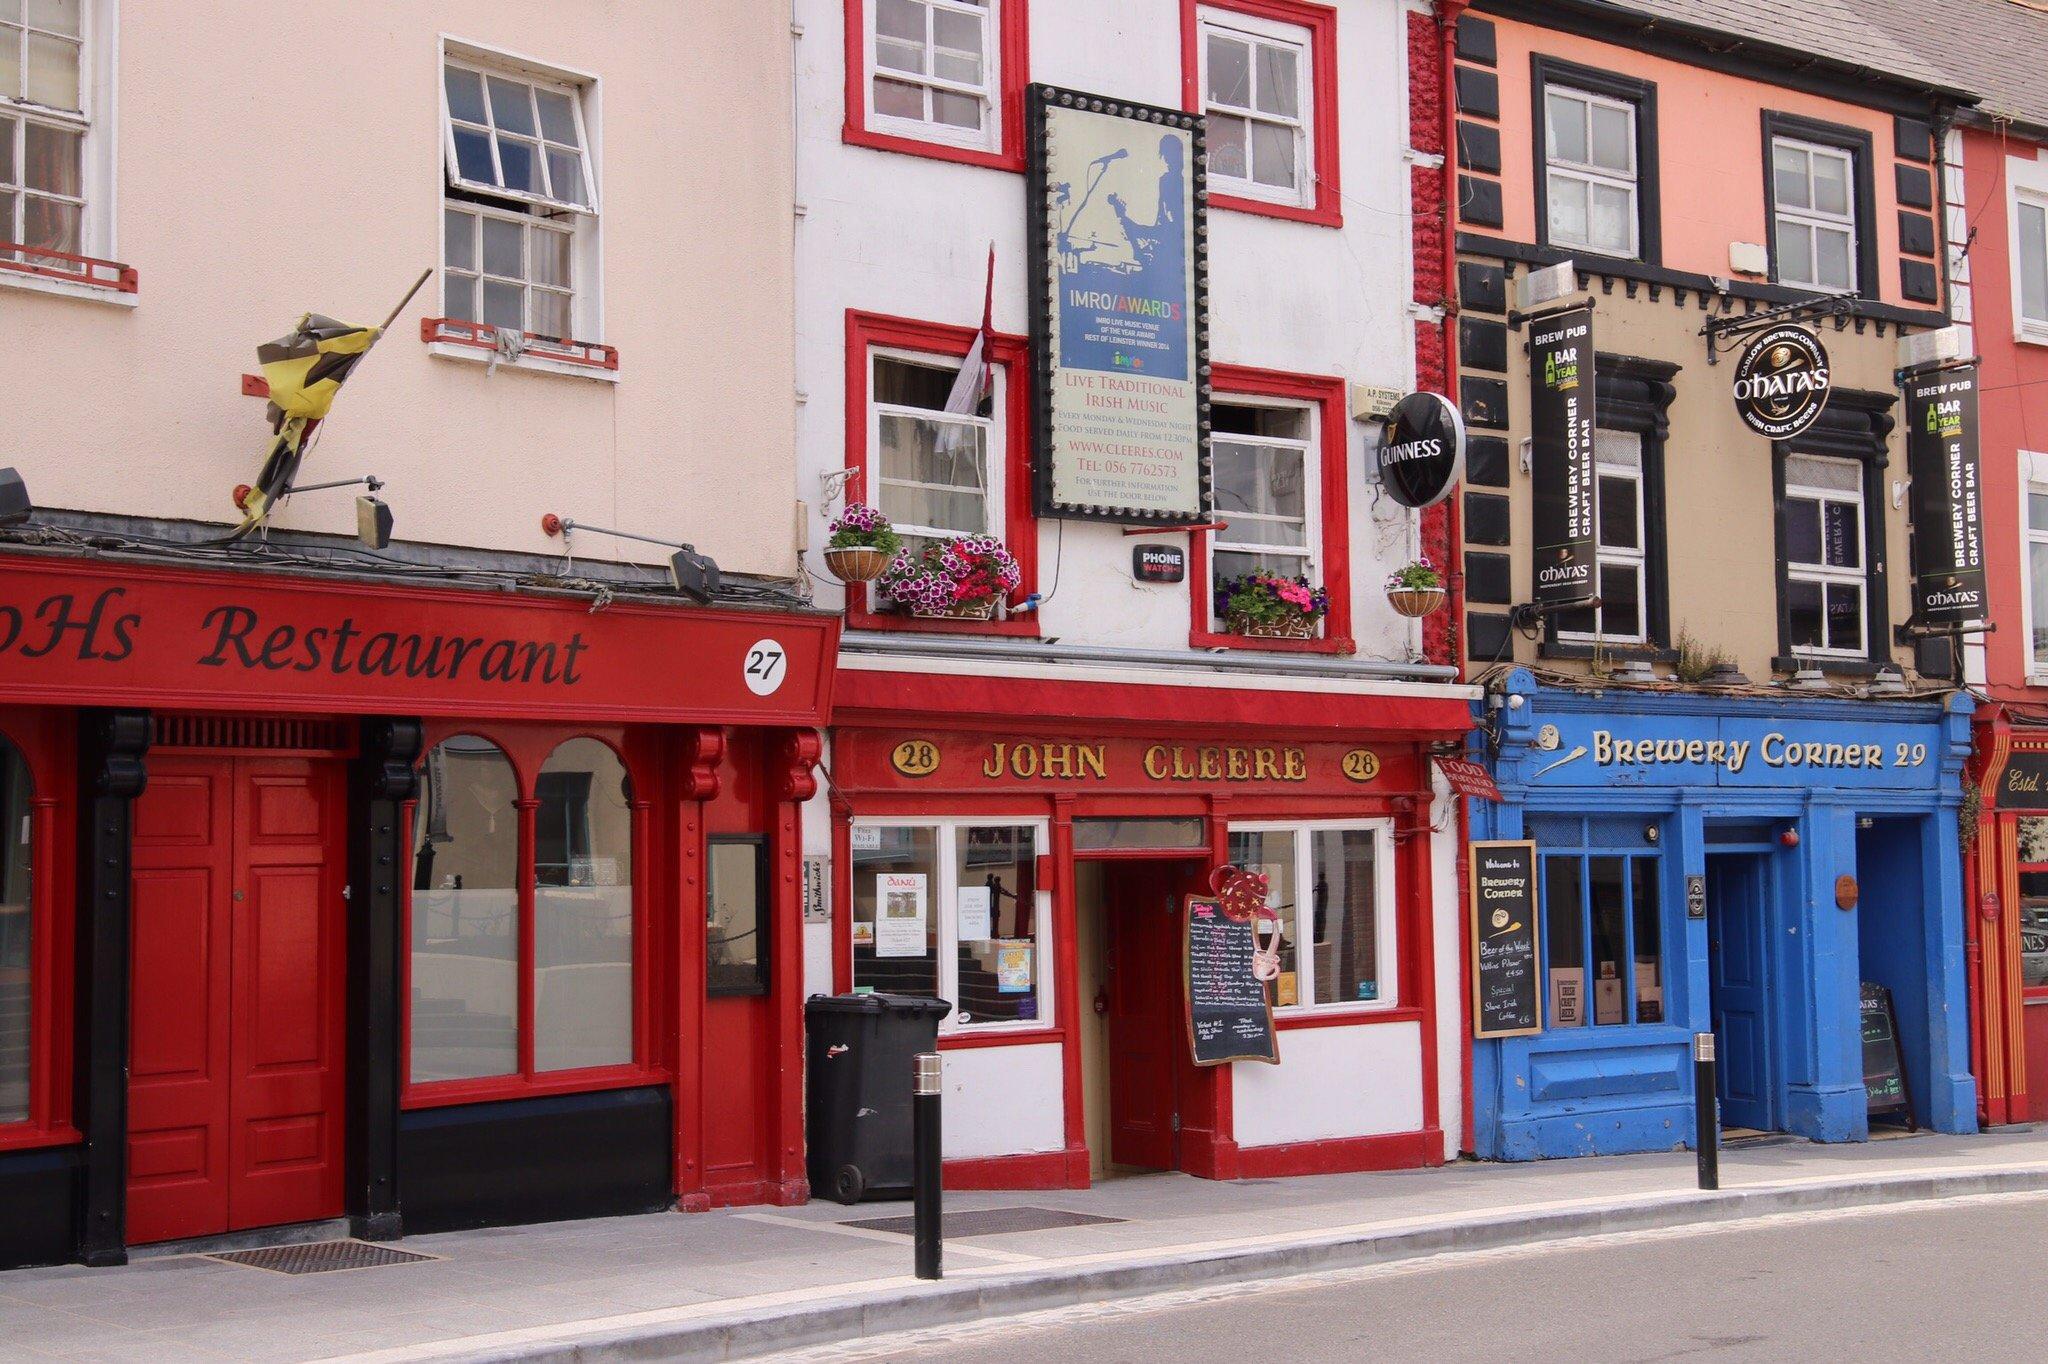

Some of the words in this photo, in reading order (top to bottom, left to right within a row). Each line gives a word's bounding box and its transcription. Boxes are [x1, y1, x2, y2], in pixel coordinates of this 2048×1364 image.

[1070, 289, 1181, 320] IMRO/AWARDS
[1110, 327, 1120, 335] THE
[1121, 329, 1136, 337] YEAR
[1137, 331, 1155, 339] AWARD
[1111, 318, 1123, 326] LIVE
[1124, 320, 1141, 329] MUSIC
[1142, 322, 1160, 331] VENUE
[1535, 330, 1564, 346] BREW
[1566, 325, 1587, 339] PUB
[1555, 347, 1577, 365] BAR
[1741, 340, 1763, 377] CARLOW
[1762, 331, 1799, 345] BREWING
[1799, 334, 1824, 367] COMPANY
[1065, 373, 1094, 388] LIVE
[1556, 366, 1577, 379] YEAR
[1916, 384, 1947, 398] BREW
[1949, 380, 1971, 393] PUB
[1086, 393, 1122, 409] IRISH
[1127, 399, 1168, 414] MUSIC
[1746, 411, 1765, 430] IRISH
[1792, 402, 1818, 427] BEERS
[1937, 400, 1961, 415] BAR
[1567, 397, 1578, 460] CORNER
[1581, 418, 1590, 447] BAR
[1938, 415, 1960, 427] YEAR
[1380, 439, 1441, 467] GUINNESS
[1105, 460, 1126, 474] 056
[1581, 451, 1591, 486] BEER
[1950, 443, 1962, 499] CORNER
[1965, 462, 1975, 488] BAR
[1568, 465, 1578, 538] BREWERY
[1582, 492, 1591, 536] CRAFT
[1966, 491, 1977, 522] BEER
[1952, 503, 1965, 568] BREWERY
[1968, 525, 1978, 566] CRAFT
[1143, 553, 1181, 565] PHONE
[1144, 563, 1174, 573] WATCH
[197, 605, 589, 685] Restaurant
[747, 651, 782, 680] 27
[902, 744, 932, 768] 28
[983, 743, 1107, 779] JOHN
[1144, 745, 1307, 781] CLEERE
[1349, 752, 1374, 774] 28
[1893, 742, 1926, 767] 29
[1439, 759, 1484, 777] FOOD
[2008, 769, 2038, 792] Estd.
[813, 861, 826, 916] Smithwick's
[1480, 941, 1498, 956] Beer
